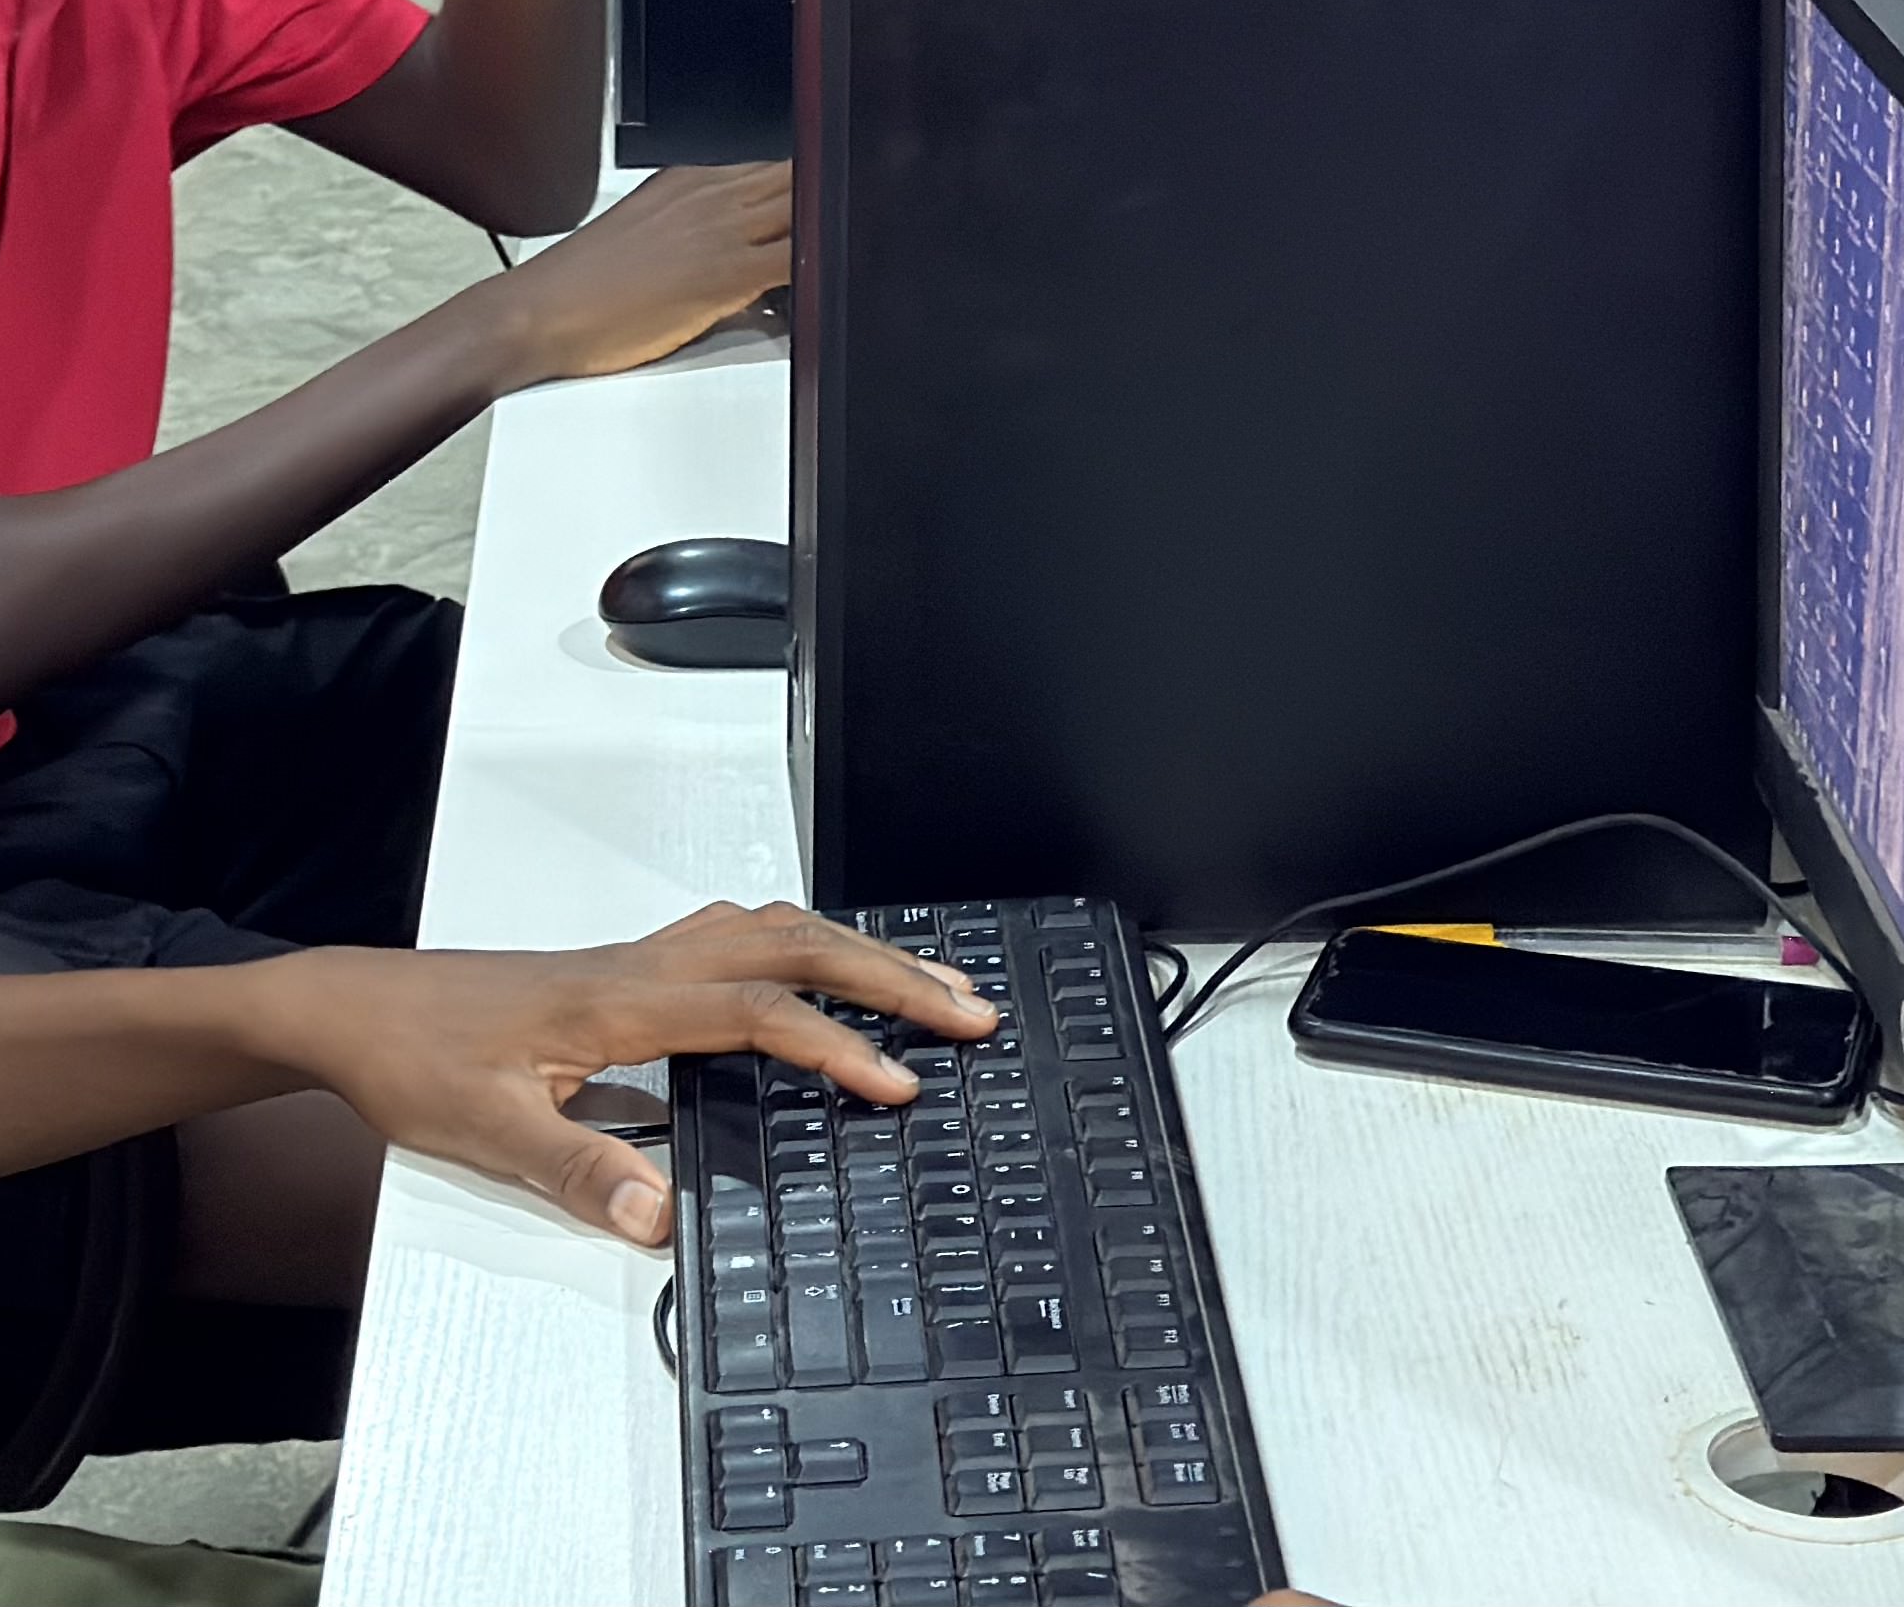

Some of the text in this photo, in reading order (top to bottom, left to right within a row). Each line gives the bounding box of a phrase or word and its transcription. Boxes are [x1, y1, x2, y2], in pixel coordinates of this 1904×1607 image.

[918, 947, 936, 956] Q
[934, 1060, 952, 1068] T
[938, 1091, 956, 1099] Y
[805, 1122, 823, 1131] N
[943, 1121, 960, 1130] U
[808, 1152, 826, 1163] M
[879, 1164, 897, 1172] K
[952, 1184, 971, 1194] O
[1003, 1532, 1021, 1541] 7
[927, 1538, 942, 1547] 4
[930, 1580, 946, 1588] 5
[1010, 1576, 1026, 1585] 8
[848, 1584, 865, 1592] 2
